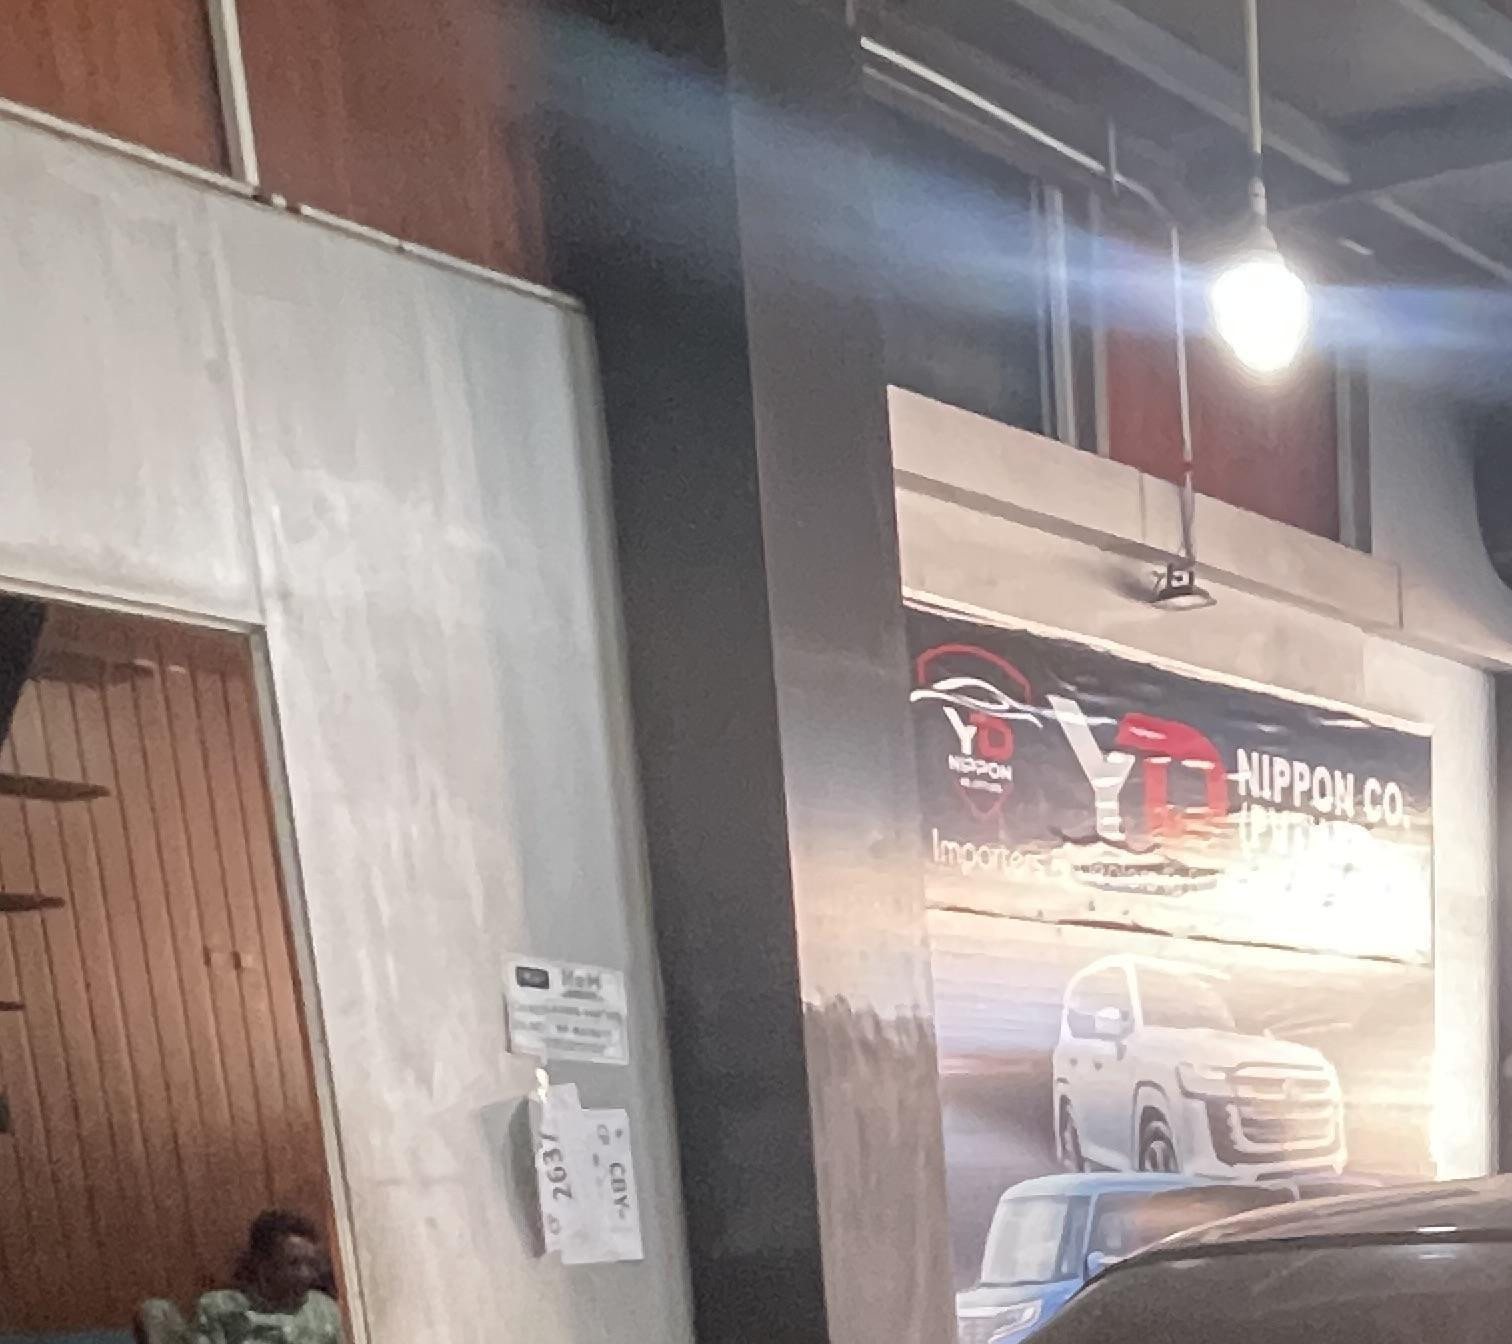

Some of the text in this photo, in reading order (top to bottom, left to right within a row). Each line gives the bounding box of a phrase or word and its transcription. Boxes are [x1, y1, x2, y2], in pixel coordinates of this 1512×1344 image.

[948, 754, 1013, 781] NIPPON
[1236, 748, 1411, 829] NIPPON CO.
